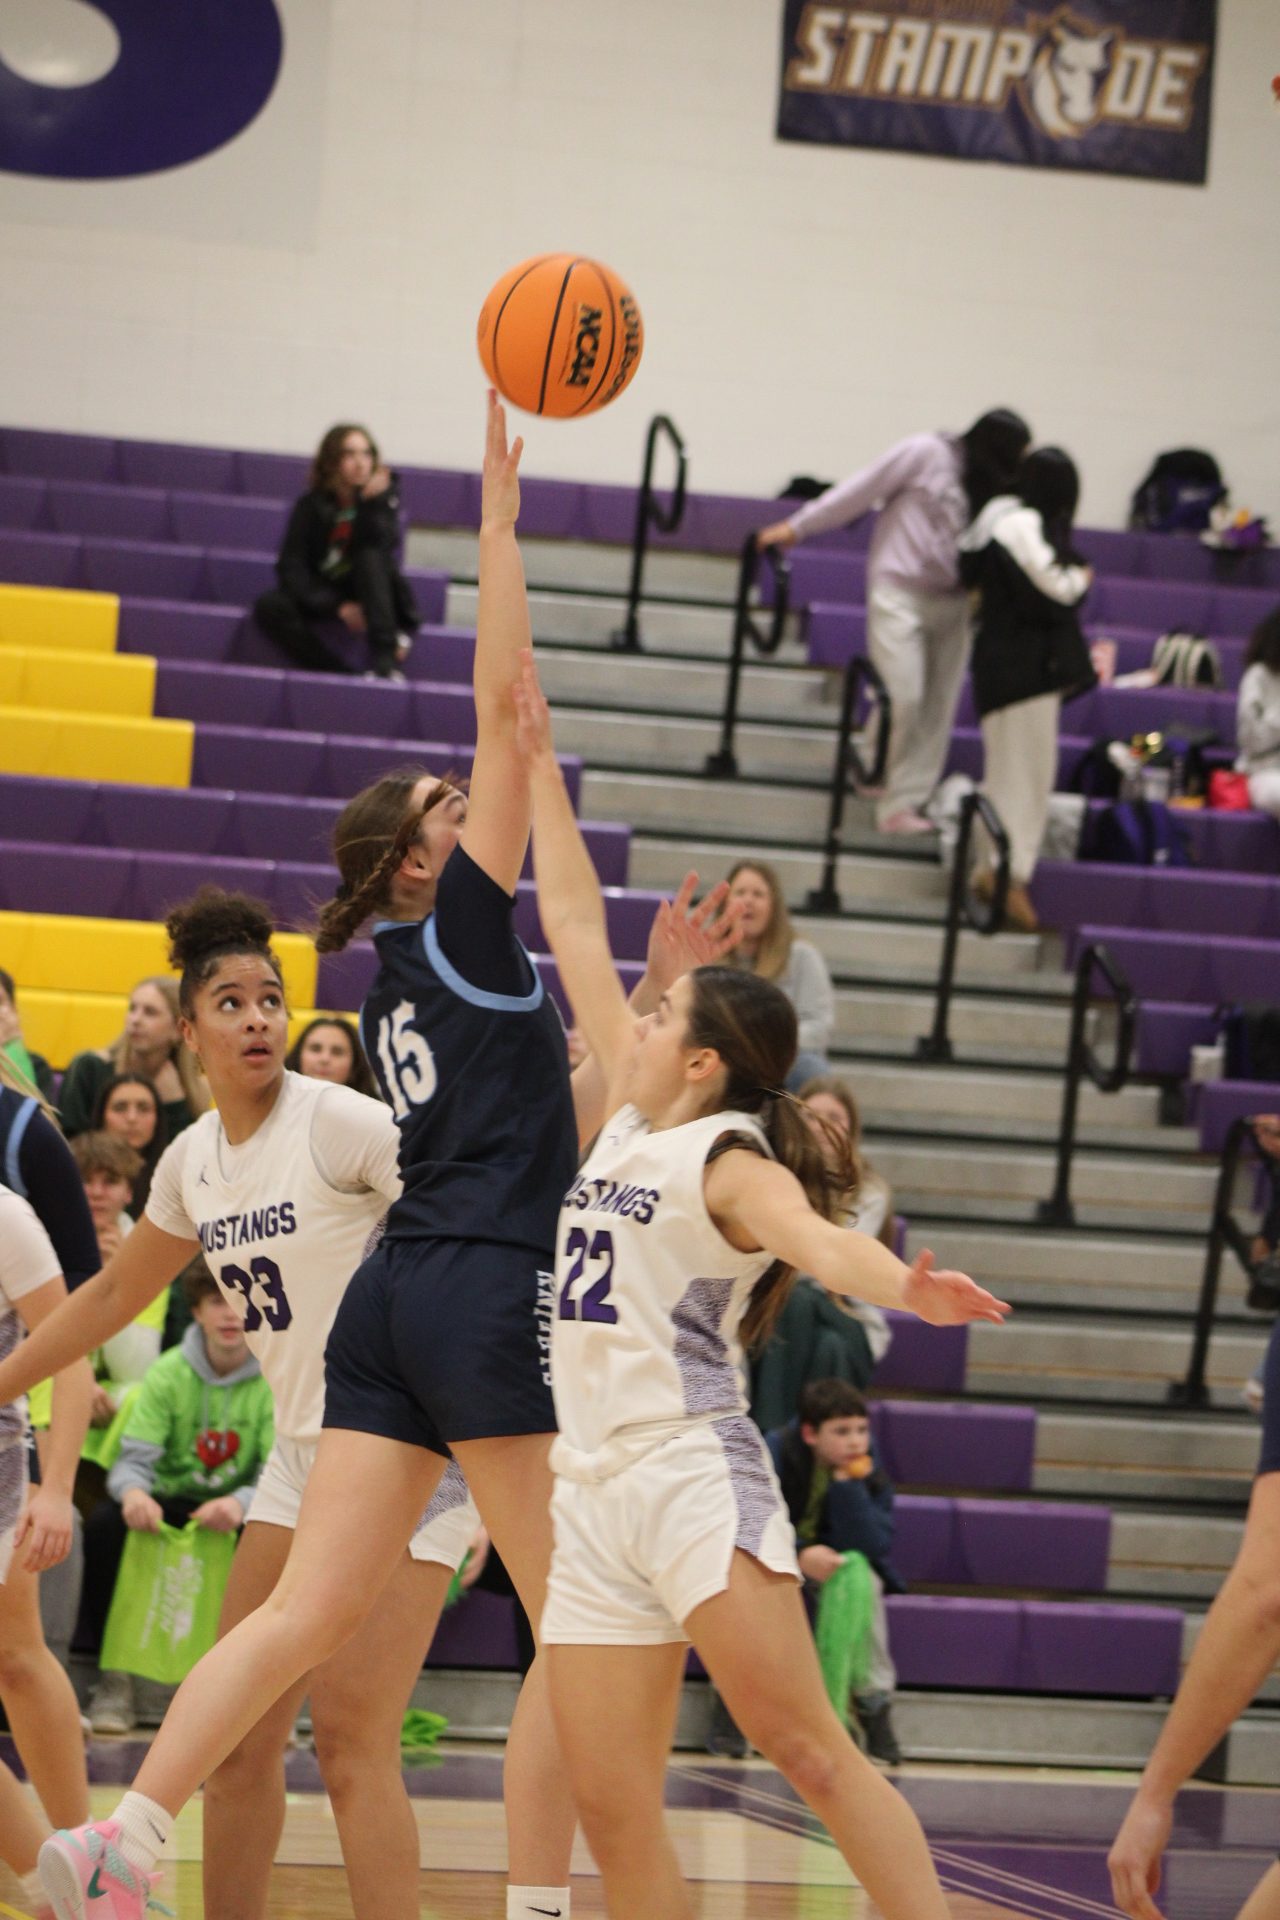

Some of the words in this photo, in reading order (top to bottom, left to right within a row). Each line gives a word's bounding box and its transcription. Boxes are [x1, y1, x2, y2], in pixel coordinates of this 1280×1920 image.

[565, 302, 603, 388] NCAA
[377, 998, 438, 1122] 15
[220, 1256, 293, 1332] 33
[559, 1227, 618, 1324] 22
